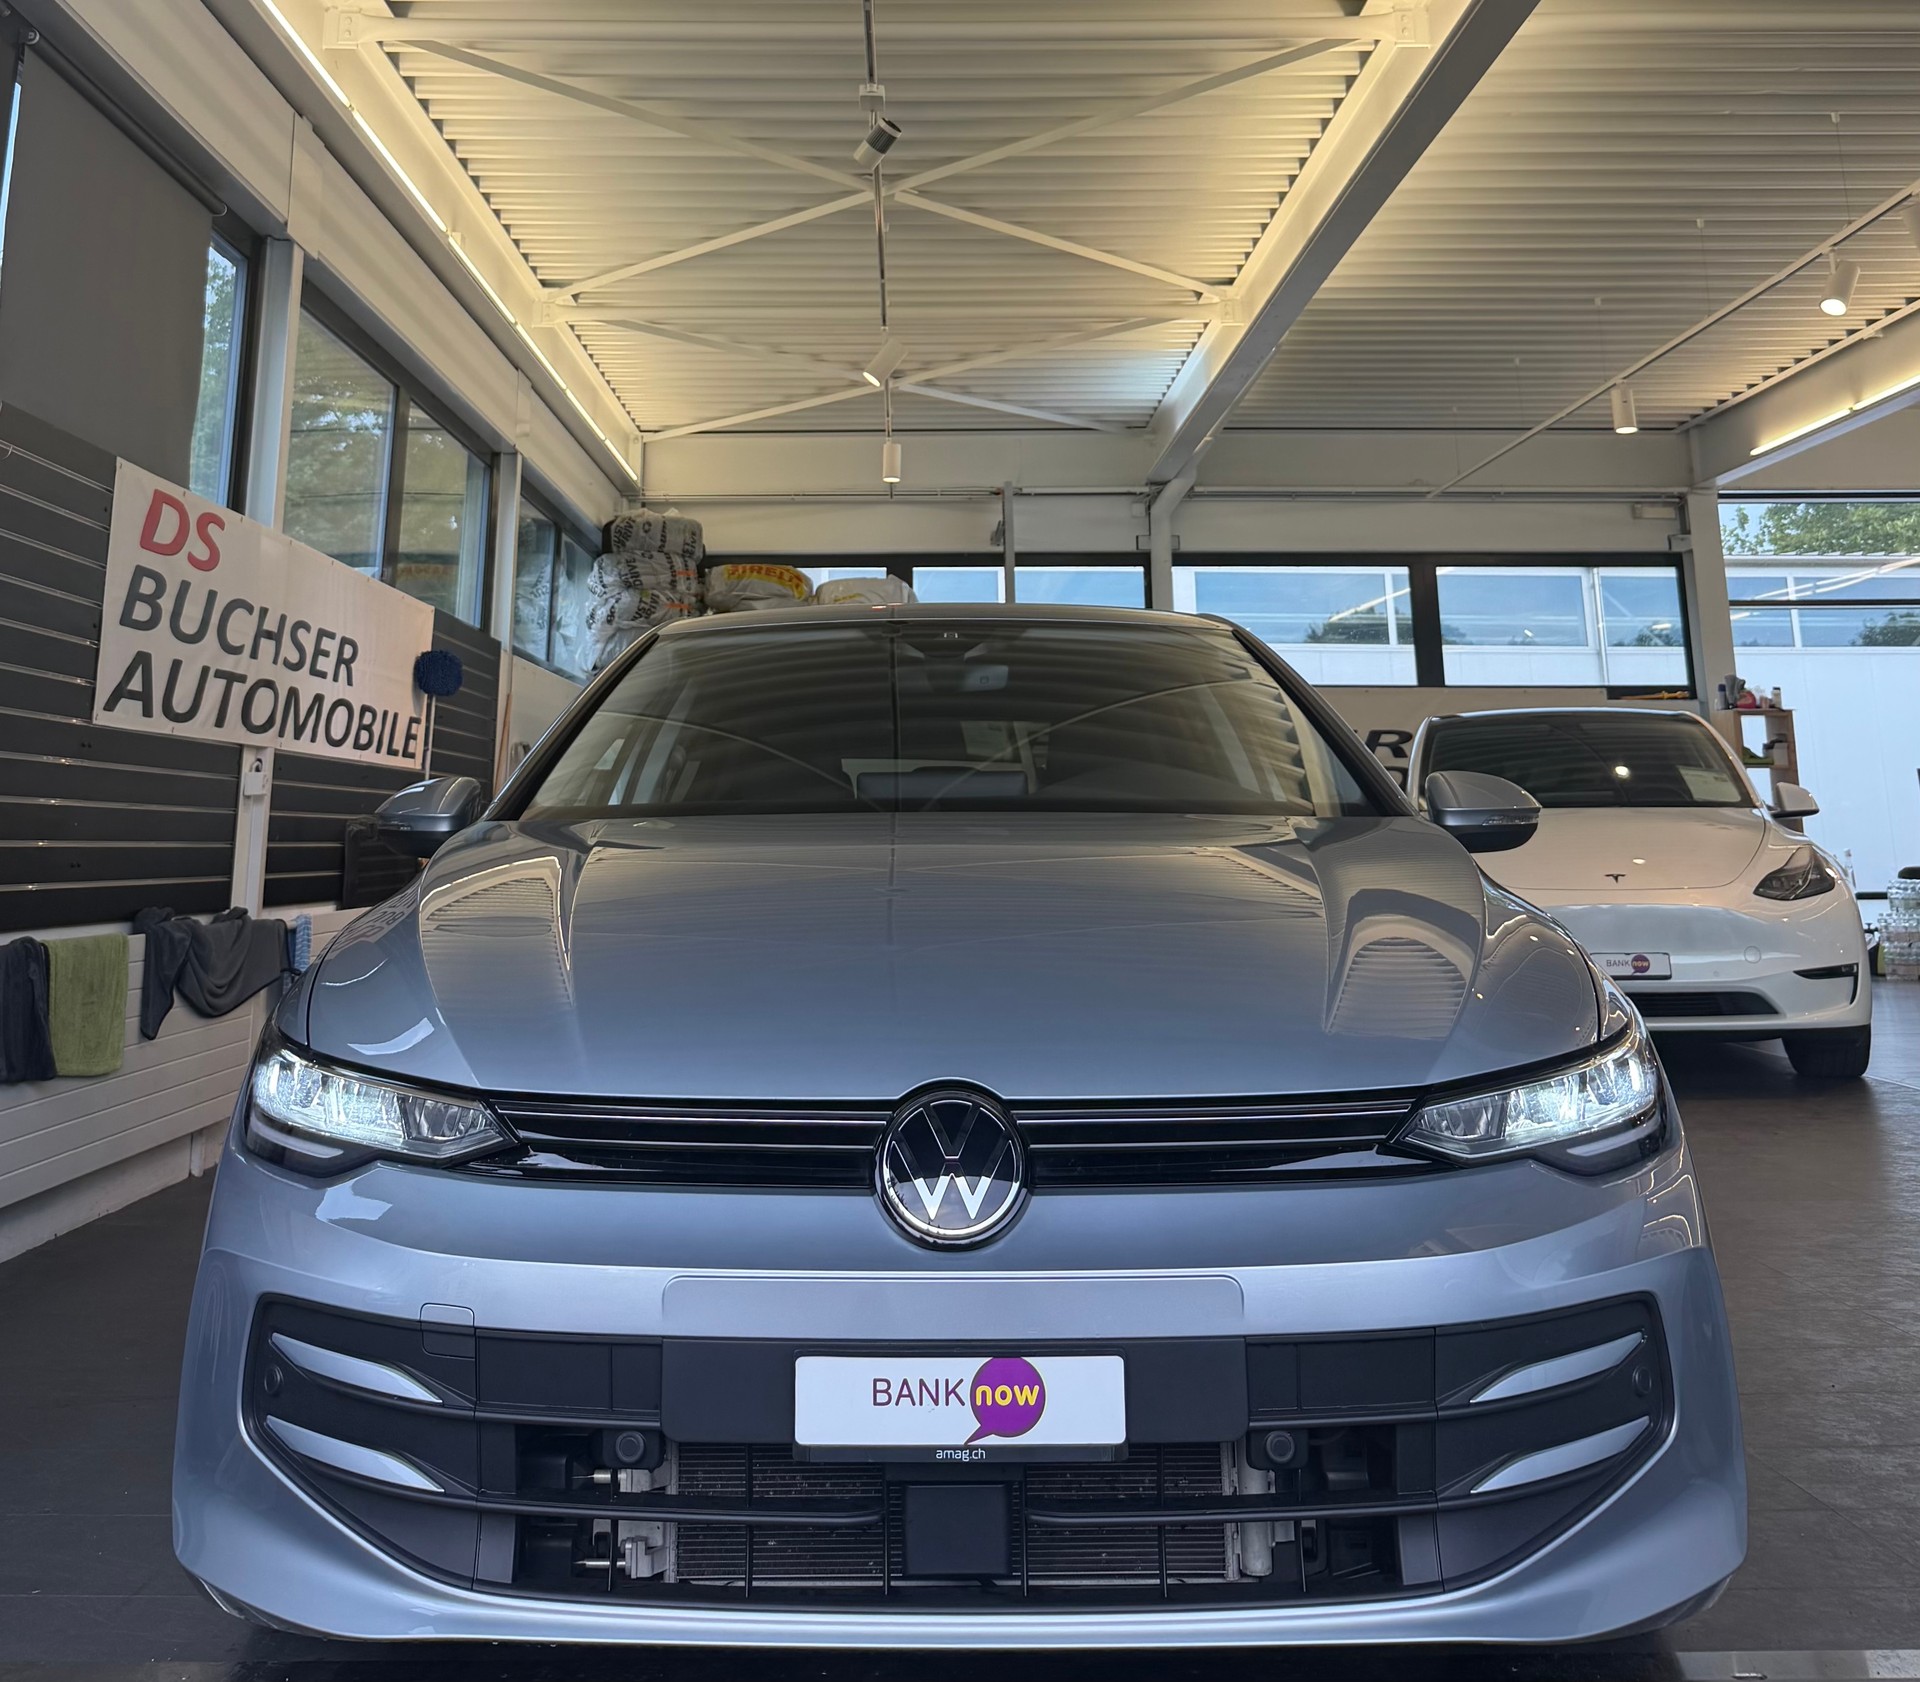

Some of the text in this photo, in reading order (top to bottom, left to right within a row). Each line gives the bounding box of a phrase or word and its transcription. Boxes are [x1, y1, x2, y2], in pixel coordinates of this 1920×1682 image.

[140, 489, 226, 572] DS
[119, 564, 359, 687] BUCHSER
[103, 650, 422, 760] AUTOMOBILE
[1606, 959, 1630, 967] BANK
[872, 1377, 1040, 1407] BANK now
[935, 1448, 986, 1461] amag.ch
